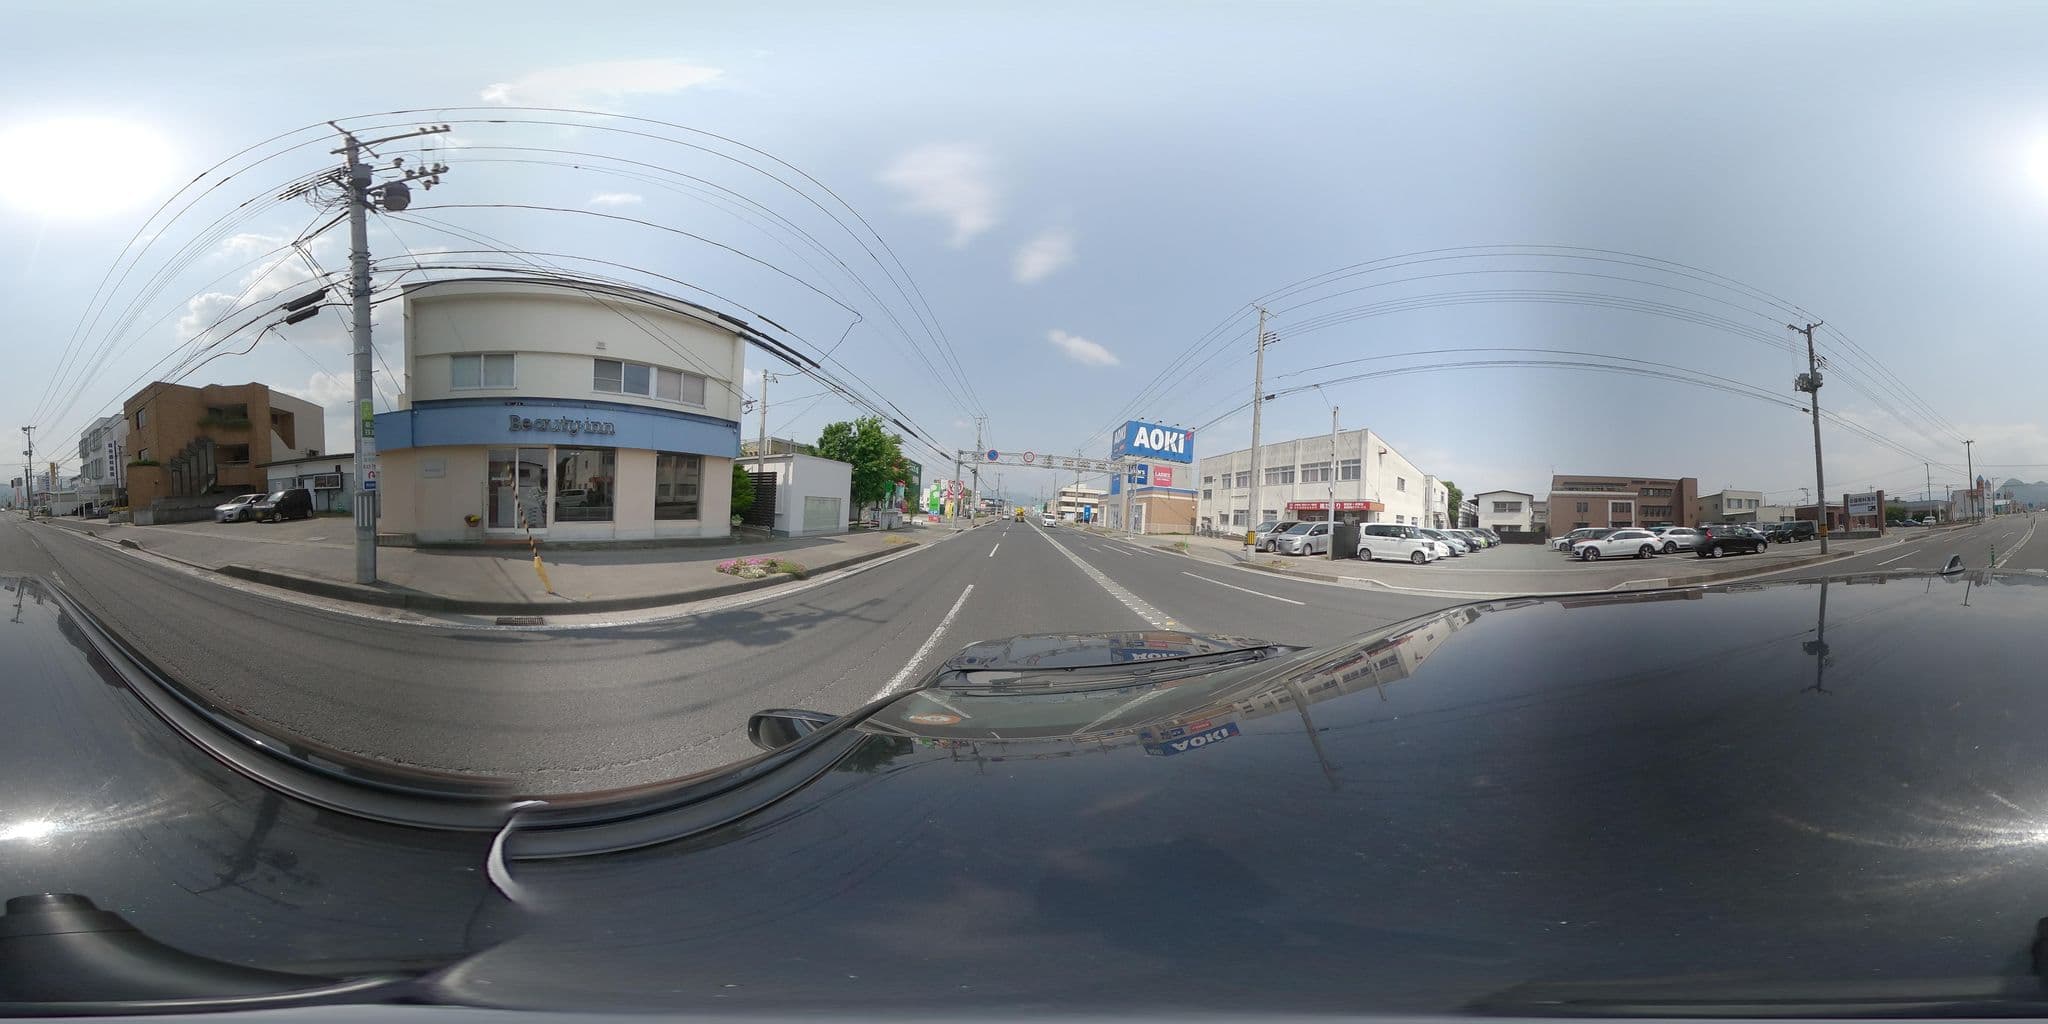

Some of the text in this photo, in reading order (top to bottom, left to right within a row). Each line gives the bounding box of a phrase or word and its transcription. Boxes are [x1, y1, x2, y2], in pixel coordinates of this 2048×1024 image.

[509, 415, 615, 437] Beauty inn
[1133, 426, 1185, 454] AOKI
